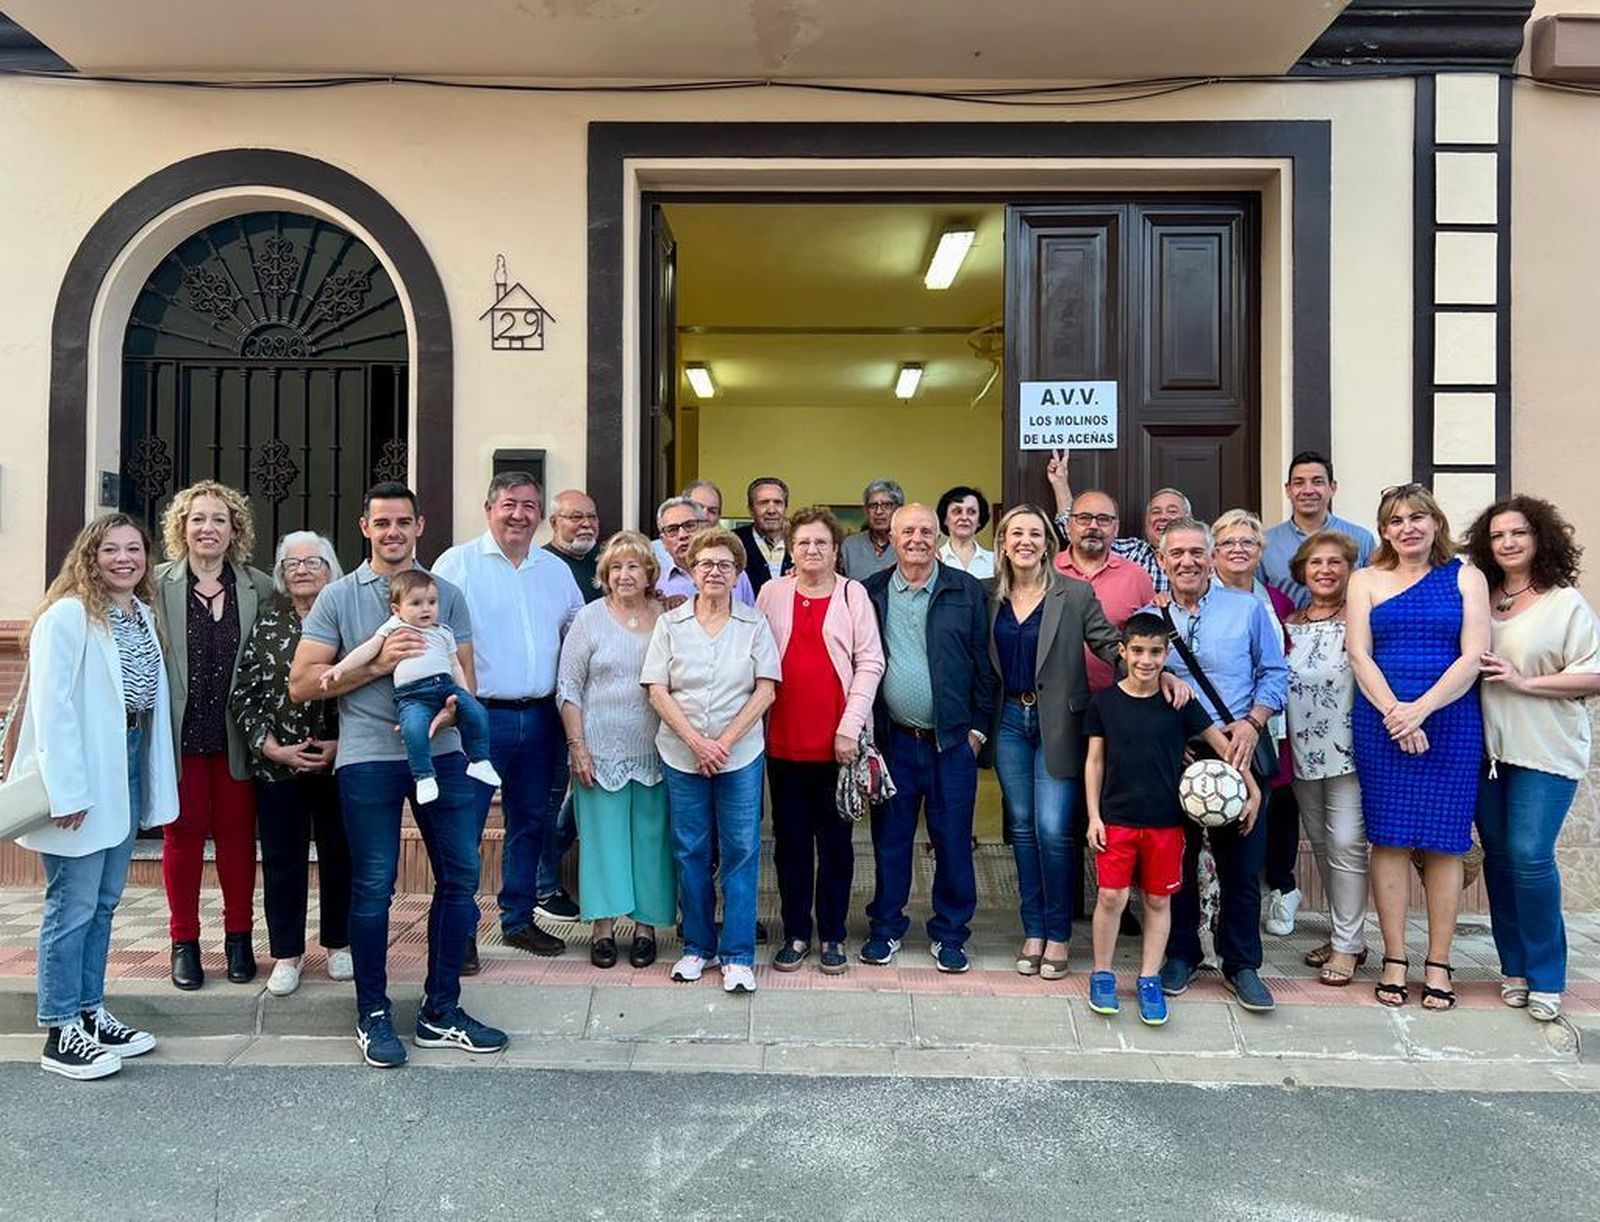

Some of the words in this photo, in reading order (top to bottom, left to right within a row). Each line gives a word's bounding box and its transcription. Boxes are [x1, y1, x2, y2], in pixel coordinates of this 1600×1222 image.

[498, 310, 540, 340] 29
[1041, 388, 1099, 406] A.V.V.
[1029, 415, 1052, 426] LOS
[1055, 415, 1109, 426] MOLINOS
[1023, 434, 1039, 445] DE
[1042, 433, 1064, 444] LAS
[1067, 431, 1115, 444] ACEÑAS
